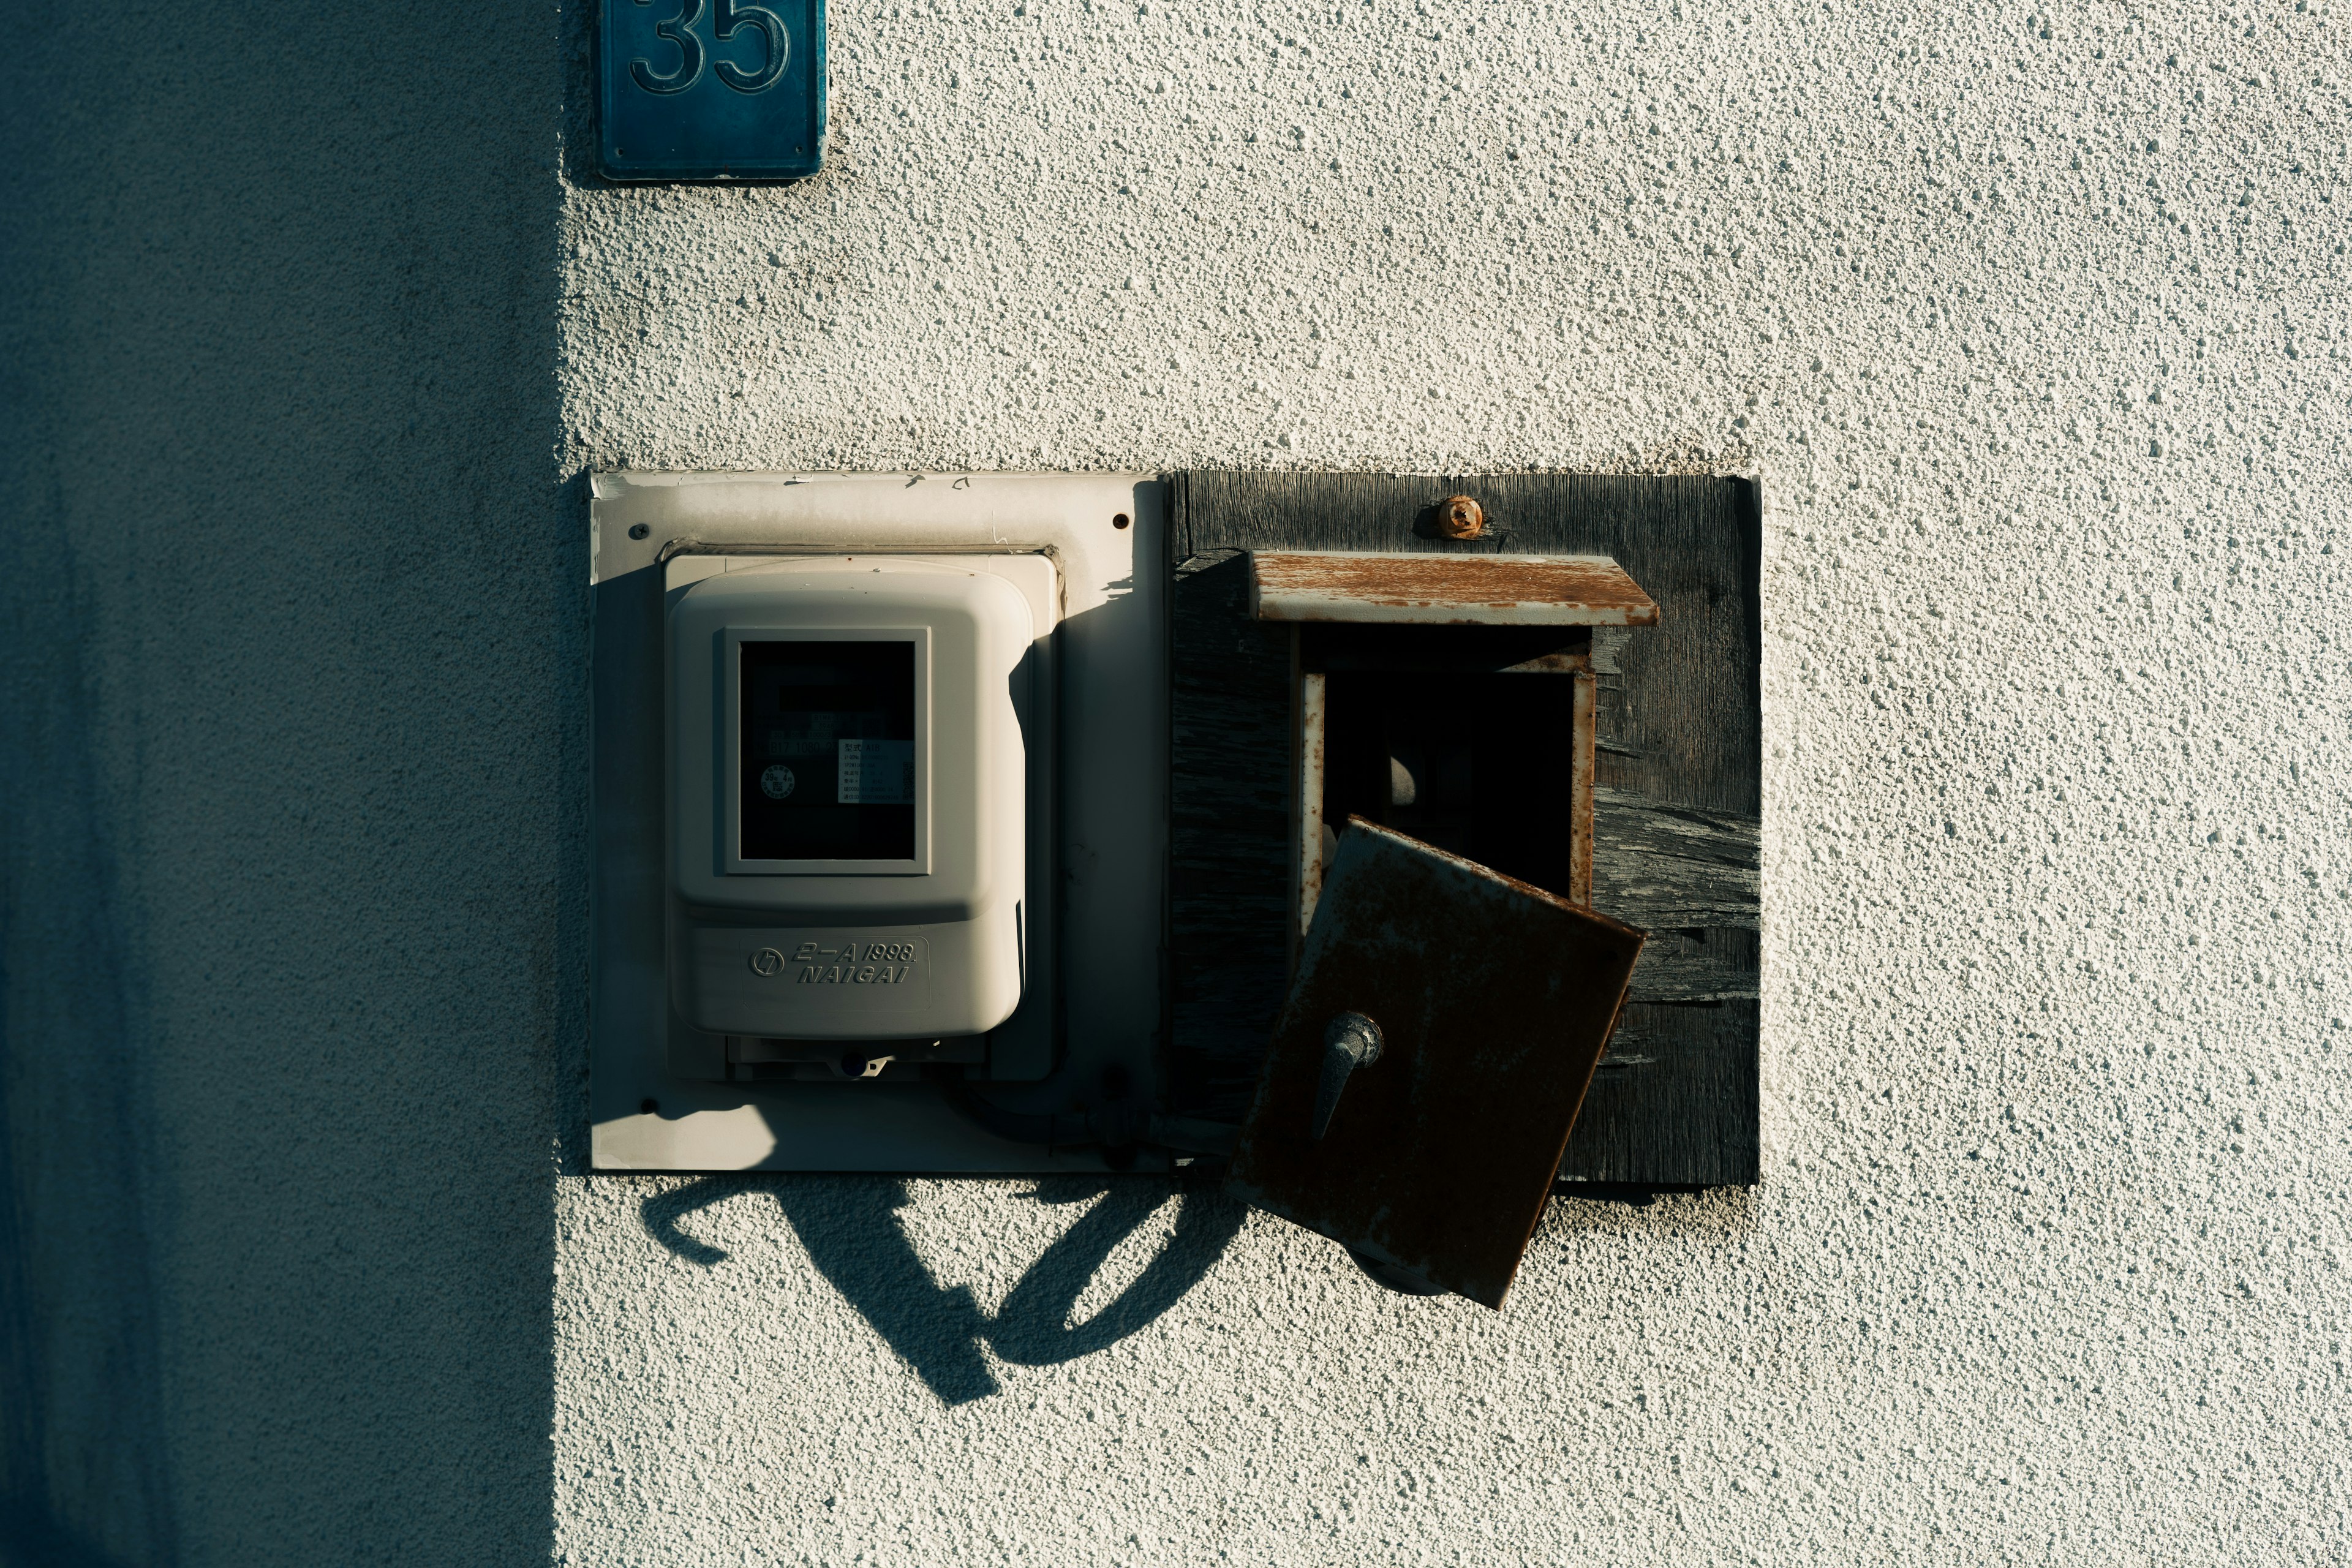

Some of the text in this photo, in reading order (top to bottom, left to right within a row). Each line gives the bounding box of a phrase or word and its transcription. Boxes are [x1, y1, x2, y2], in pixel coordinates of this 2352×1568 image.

[629, 0, 791, 96] 35
[771, 742, 790, 753] B17
[797, 742, 820, 753] 1080
[845, 743, 880, 752] 型式 A1B
[863, 943, 914, 962] 1998
[798, 966, 909, 984] NAIGAI
